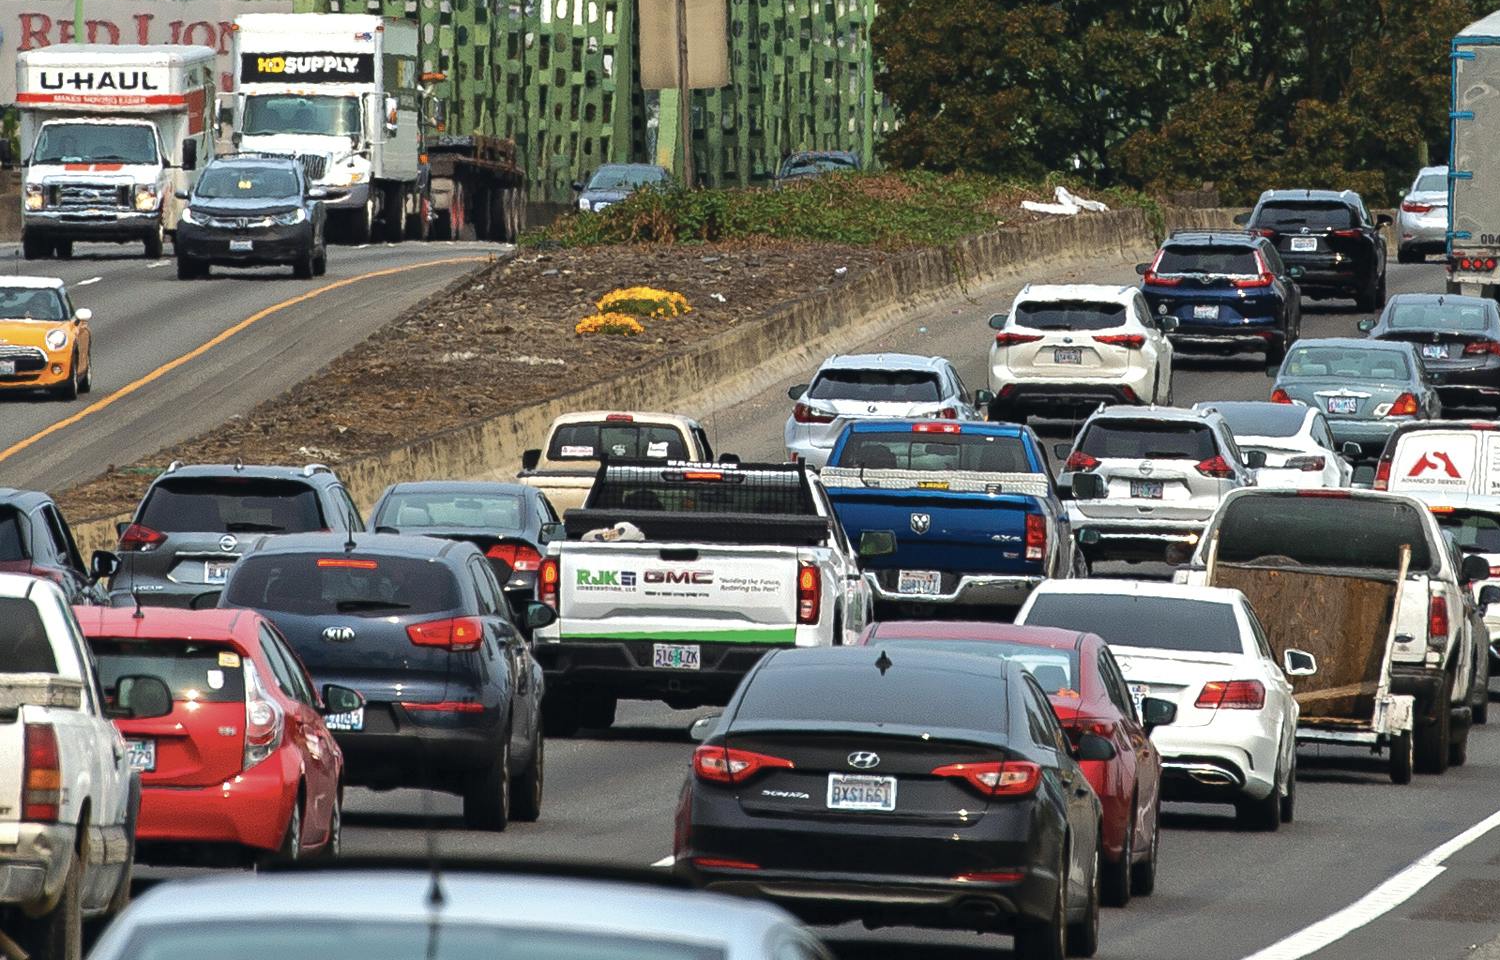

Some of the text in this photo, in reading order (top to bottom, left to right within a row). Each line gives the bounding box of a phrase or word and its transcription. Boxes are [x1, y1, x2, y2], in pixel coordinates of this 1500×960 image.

[40, 71, 158, 90] U-HAUL
[577, 569, 714, 585] RJK GMC
[324, 627, 353, 640] KIA
